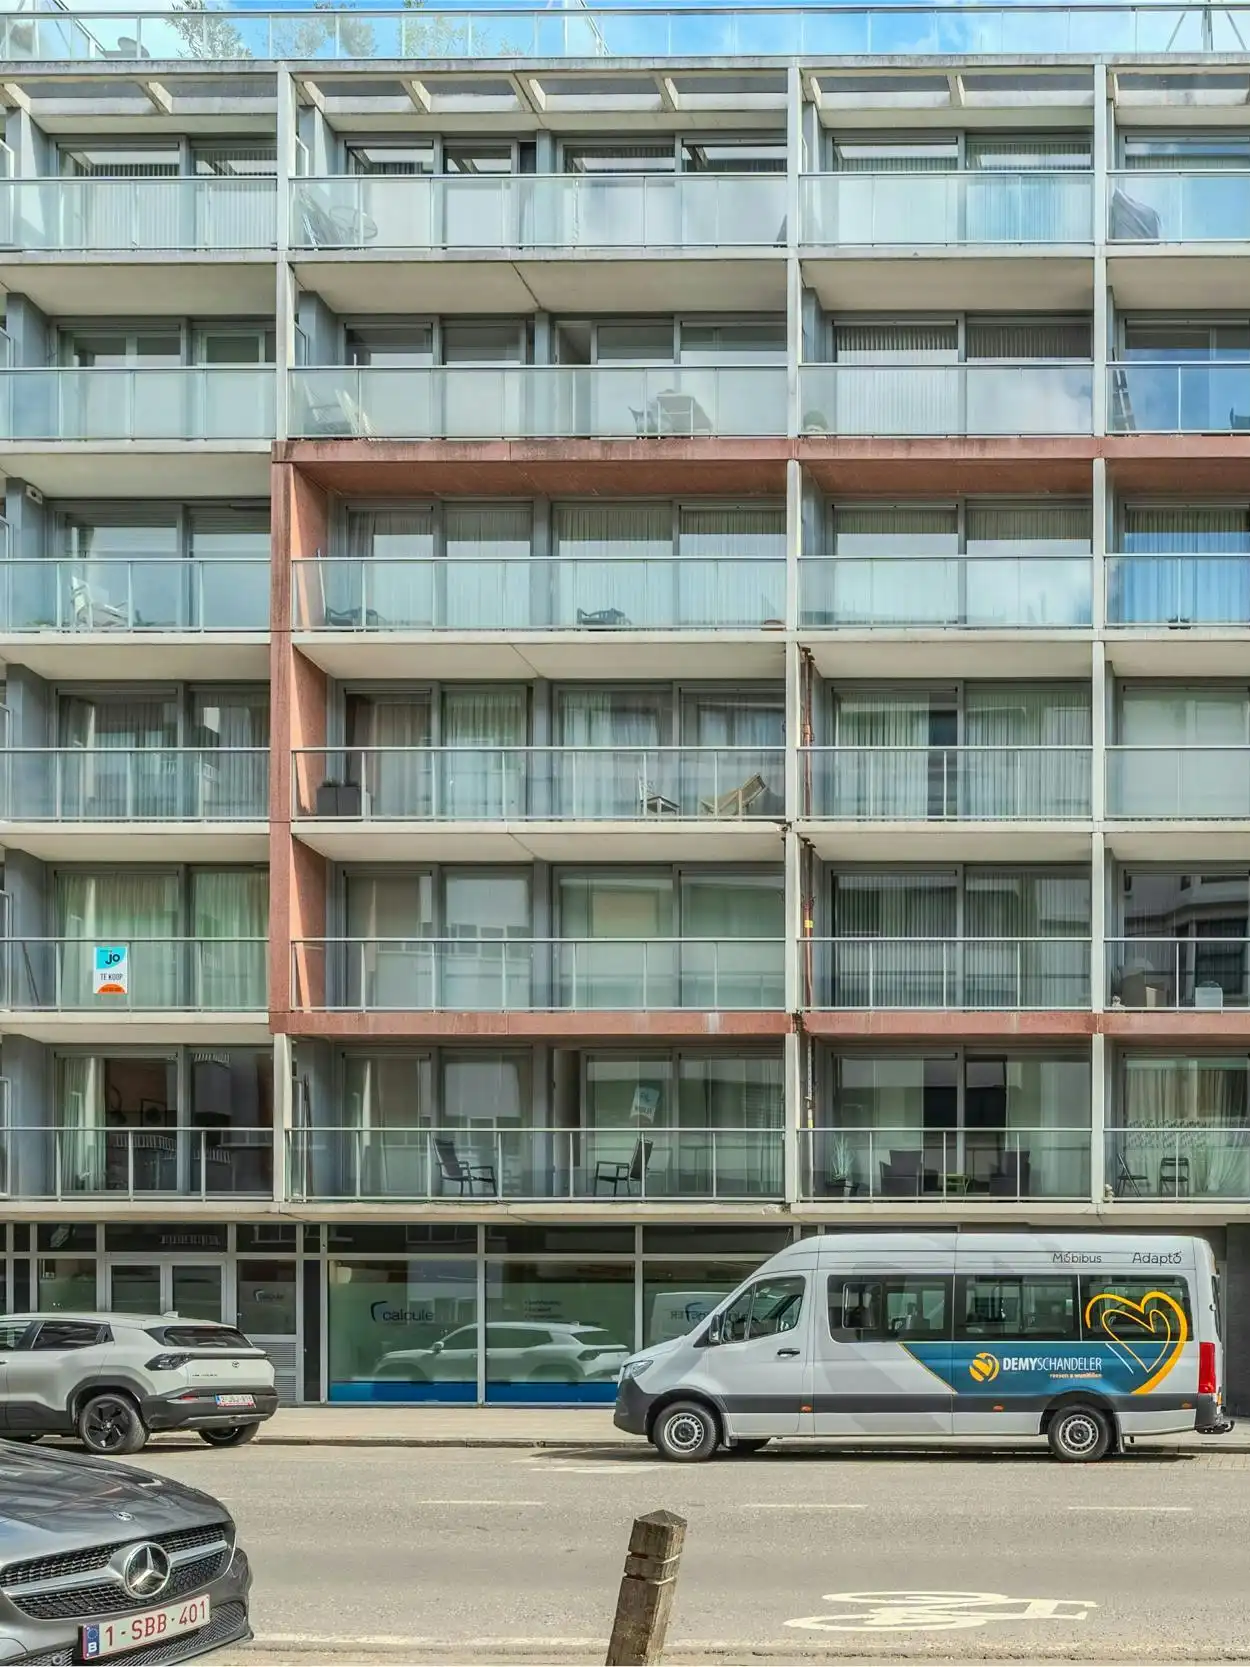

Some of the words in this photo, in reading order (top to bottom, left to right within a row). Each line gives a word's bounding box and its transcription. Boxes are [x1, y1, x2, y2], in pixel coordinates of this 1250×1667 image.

[100, 973, 106, 981] TE
[382, 1307, 434, 1321] calcule
[1002, 1357, 1103, 1371] DEMYSCHANDELER
[87, 1641, 98, 1653] B
